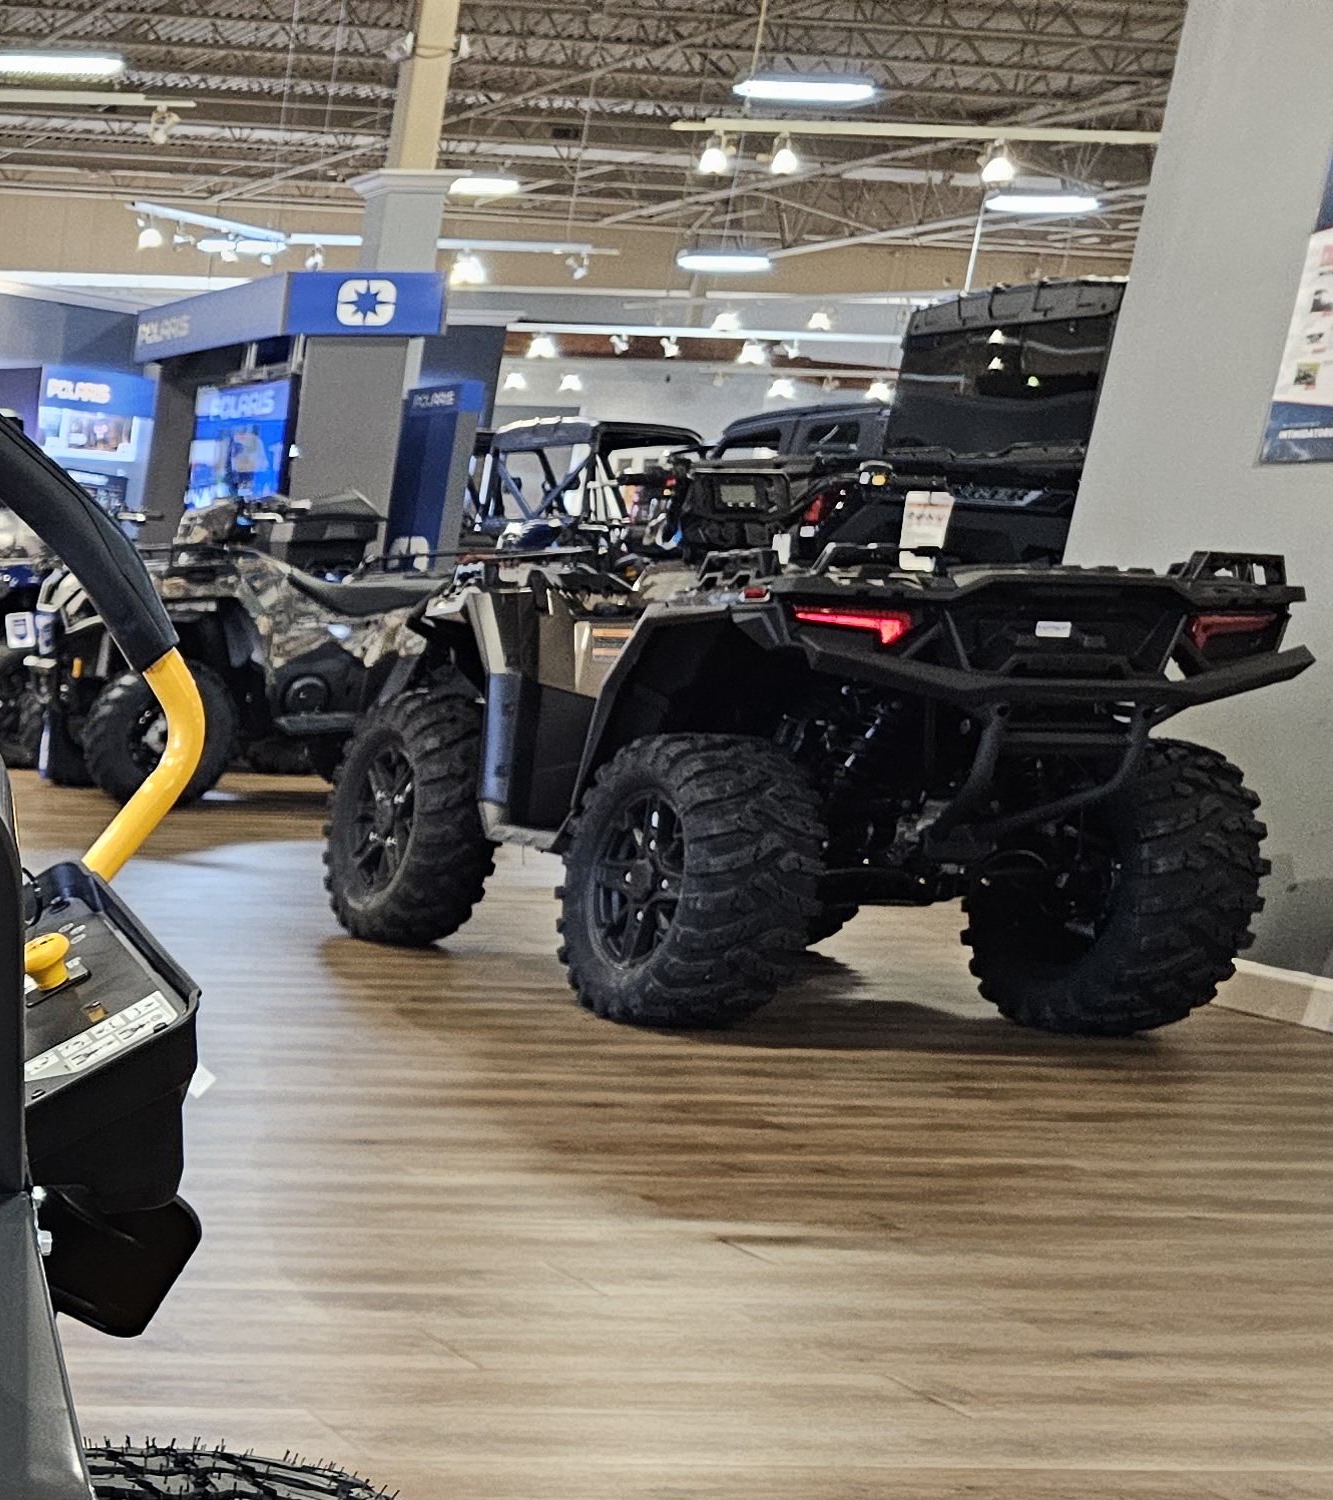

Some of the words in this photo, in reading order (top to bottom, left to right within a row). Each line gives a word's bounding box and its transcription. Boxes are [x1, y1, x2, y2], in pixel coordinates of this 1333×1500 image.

[138, 315, 190, 345] POLARIS
[47, 378, 111, 404] POLARIS
[210, 390, 275, 420] POLARIS
